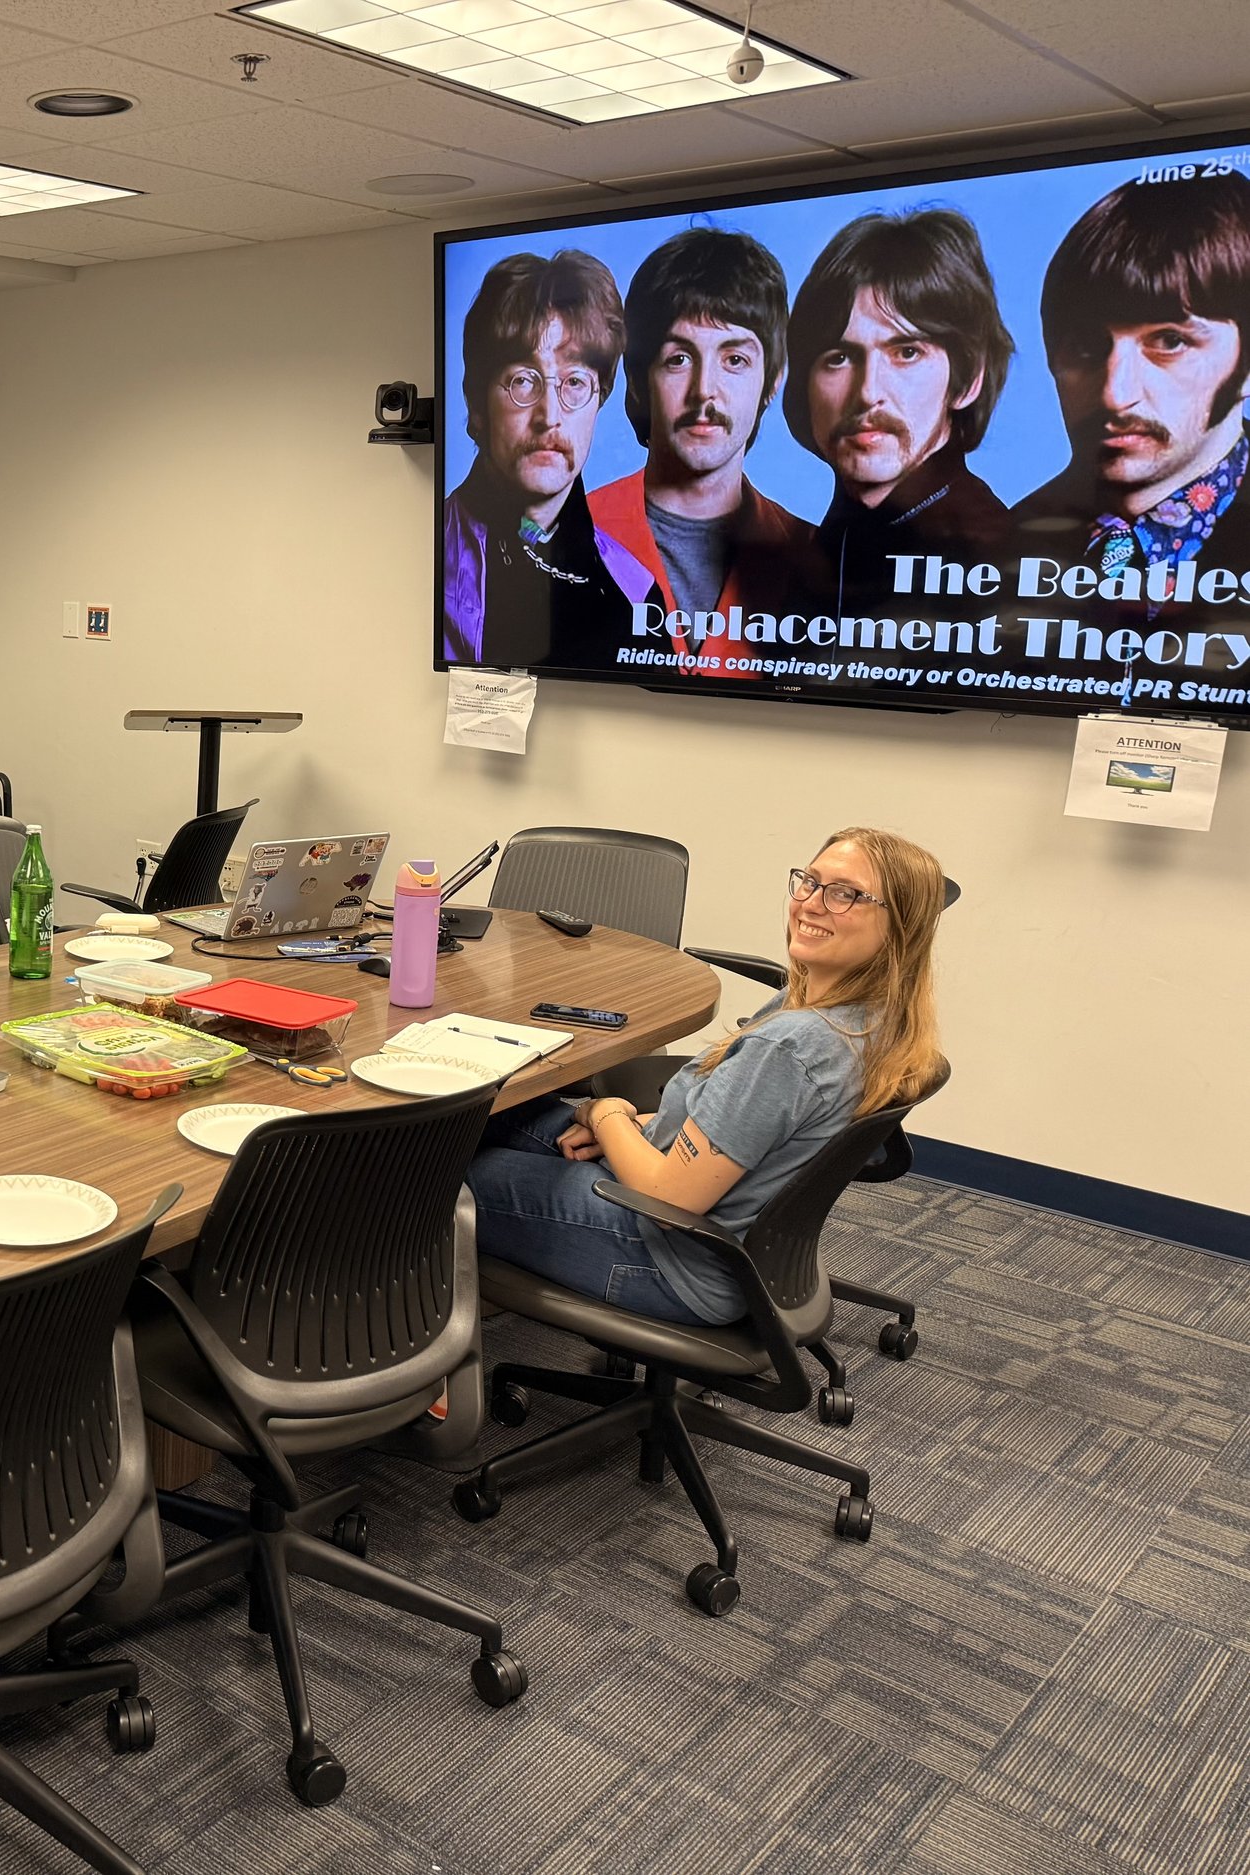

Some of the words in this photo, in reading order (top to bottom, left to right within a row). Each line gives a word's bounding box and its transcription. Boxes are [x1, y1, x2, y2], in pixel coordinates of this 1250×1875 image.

[1136, 164, 1196, 185] June
[885, 555, 1001, 596] The
[632, 602, 1002, 655] Replacement
[1017, 617, 1250, 669] Theory
[475, 683, 509, 694] Attention
[616, 647, 721, 668] Ridiculous
[724, 656, 844, 678] conspiracy
[847, 662, 923, 686] theory
[926, 668, 953, 684] or
[956, 668, 1131, 697] Orchestrated
[1132, 679, 1174, 699] PR
[1116, 736, 1182, 751] ATTENTION
